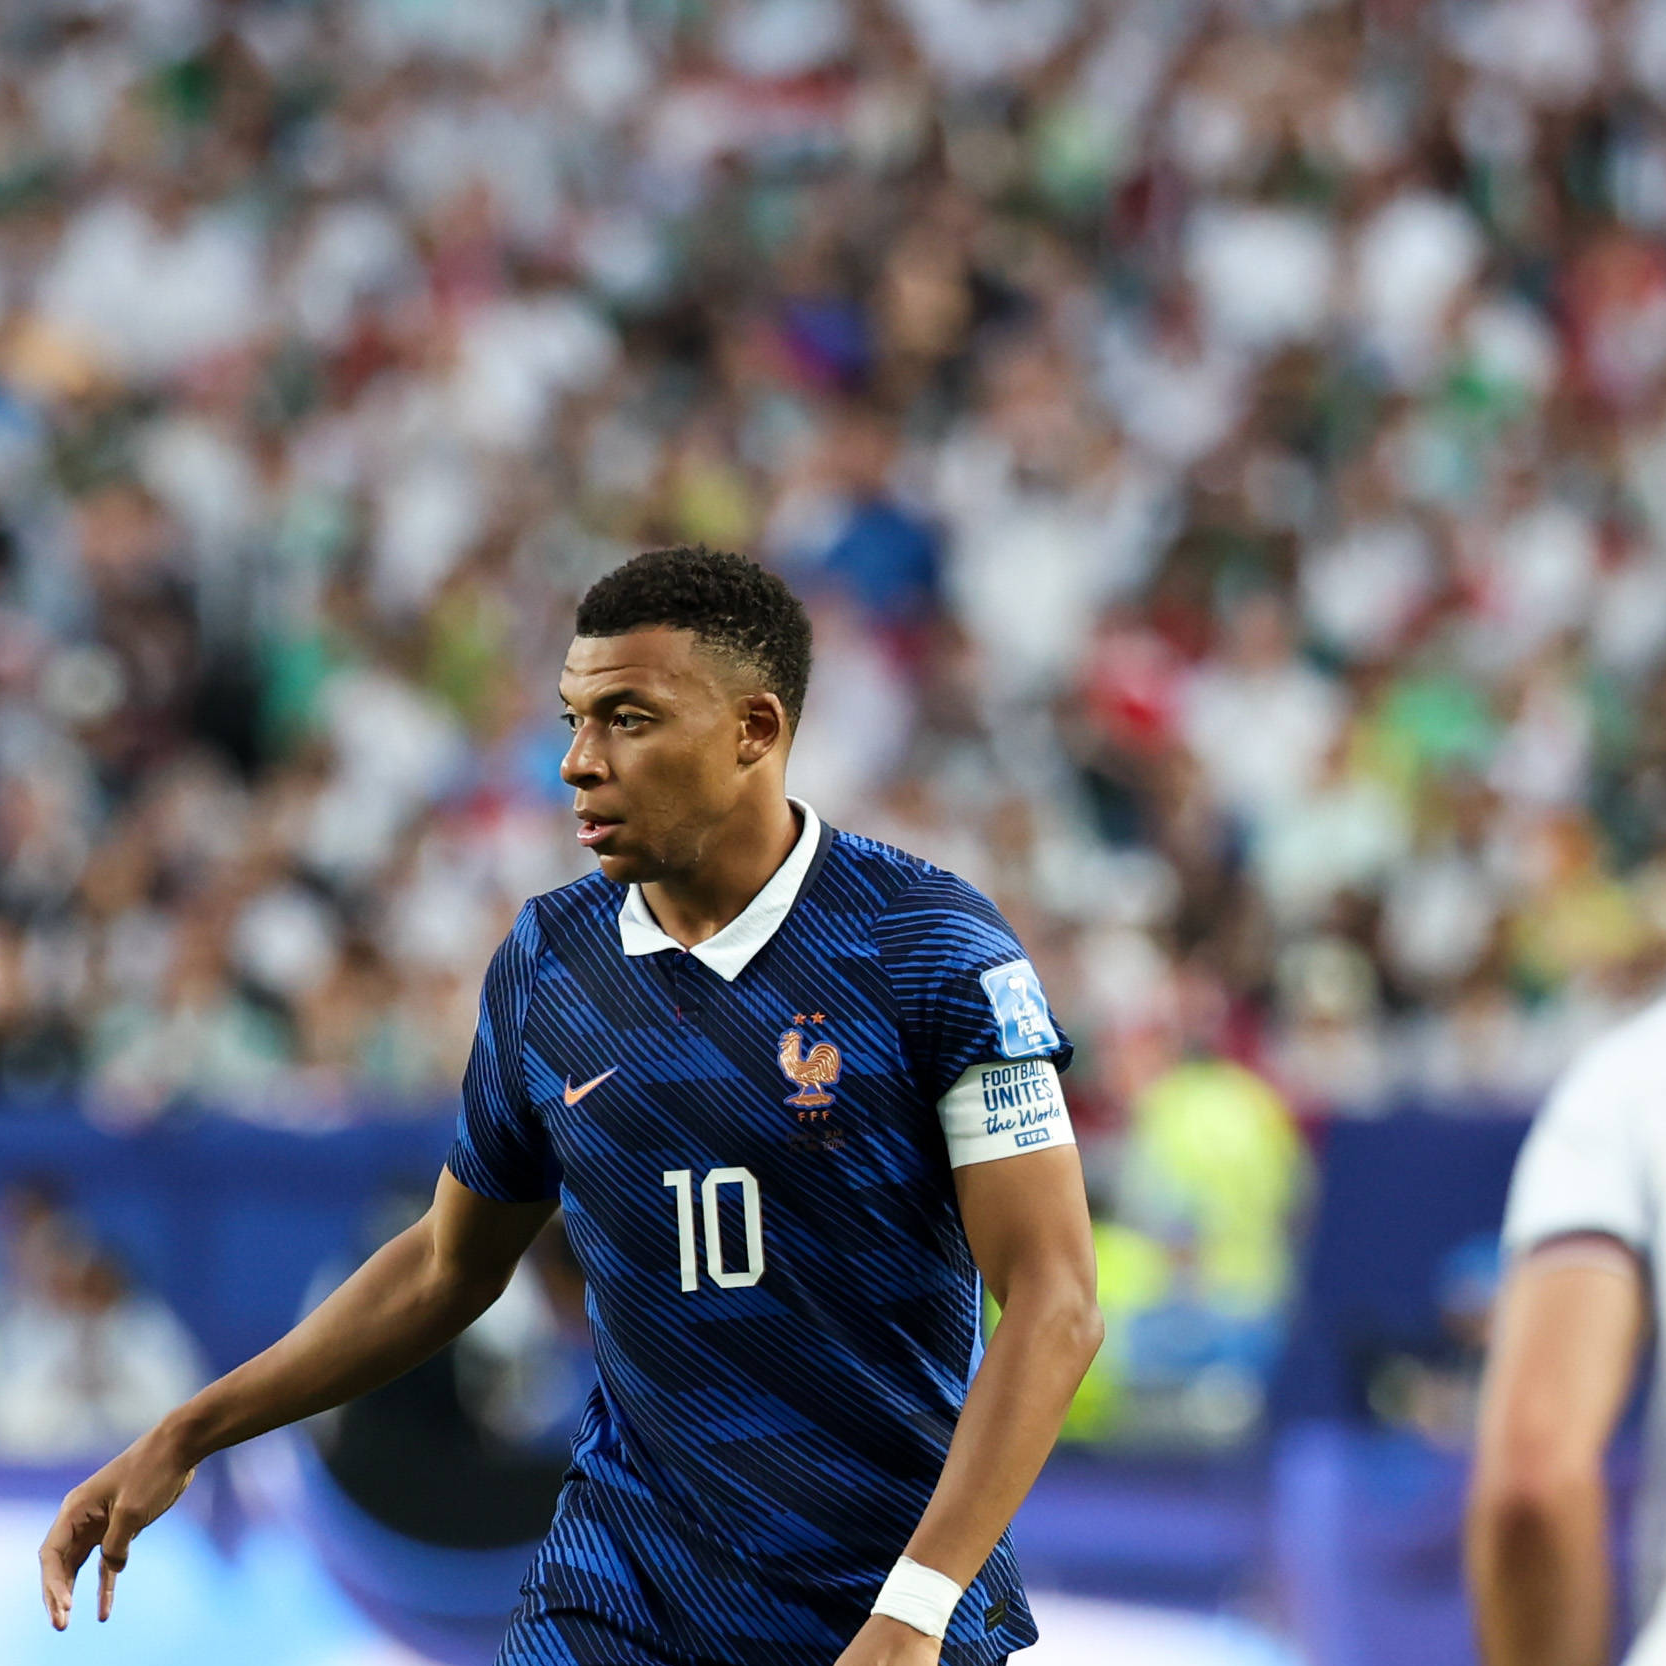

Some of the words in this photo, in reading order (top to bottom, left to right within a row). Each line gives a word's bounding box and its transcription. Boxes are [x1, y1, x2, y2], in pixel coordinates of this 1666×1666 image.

[981, 1060, 1046, 1089] FOOTBALL
[983, 1078, 1054, 1112] UNITES
[982, 1113, 1016, 1135] the
[1017, 1101, 1061, 1128] World
[1016, 1130, 1048, 1146] FIFA
[663, 1167, 764, 1292] 10
